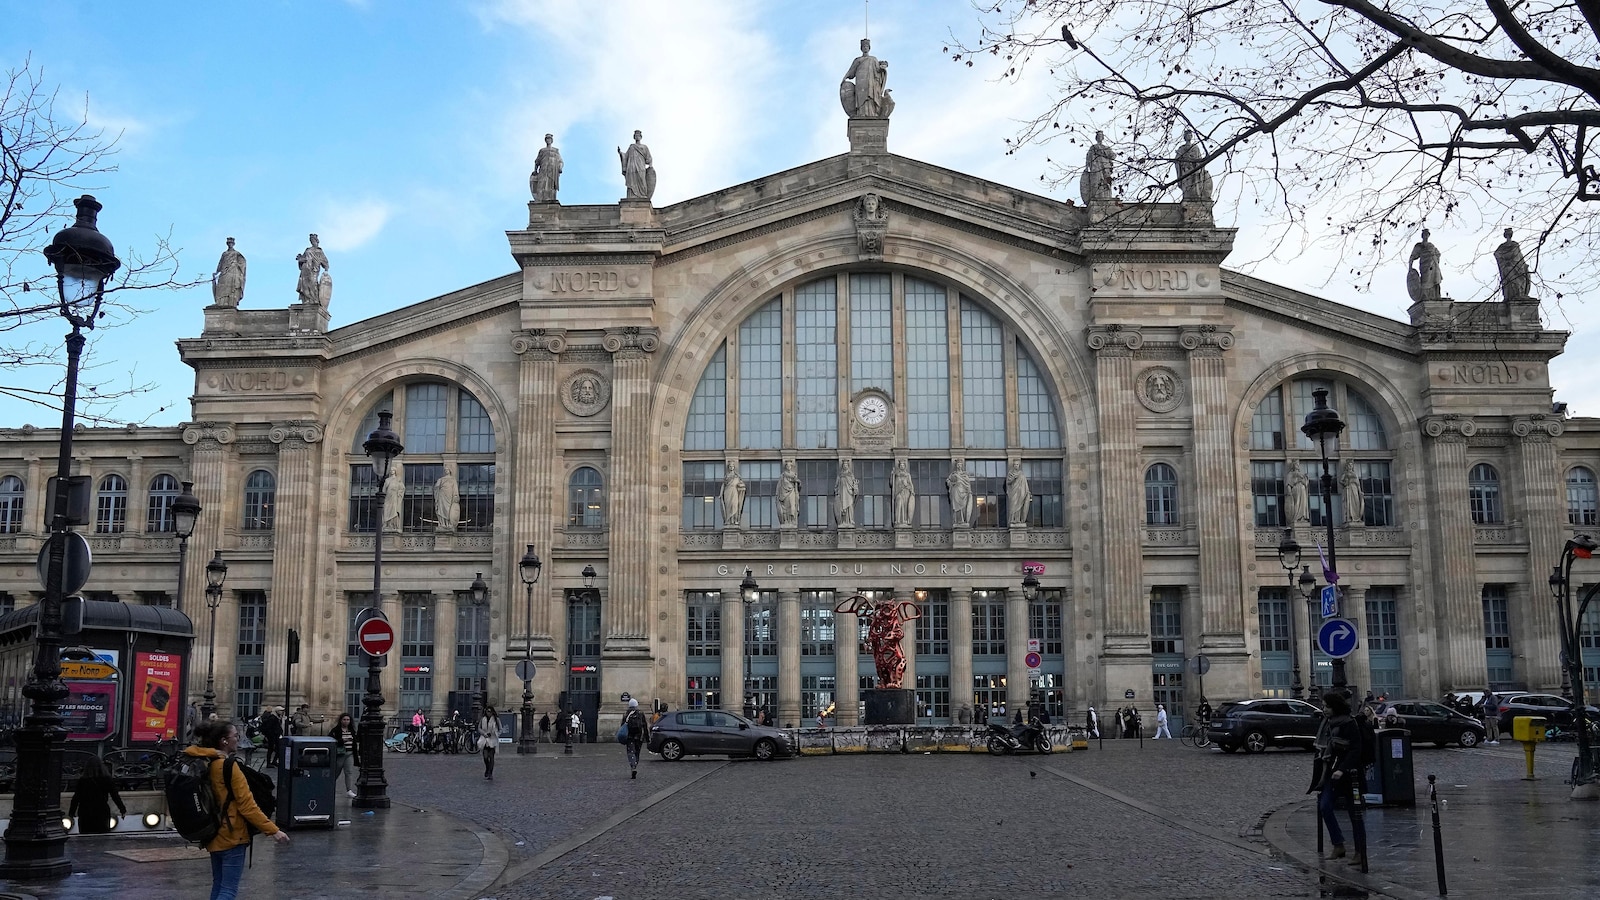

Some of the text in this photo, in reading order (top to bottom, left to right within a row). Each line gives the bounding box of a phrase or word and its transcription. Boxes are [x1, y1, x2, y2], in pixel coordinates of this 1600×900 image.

[551, 271, 619, 293] NORD
[1121, 269, 1190, 291] NORD
[221, 371, 288, 392] NORD
[1452, 365, 1519, 385] NORD
[717, 564, 973, 575] GARE DU NORD
[149, 654, 169, 662] SOLDES
[77, 703, 103, 711] MÉDOCS
